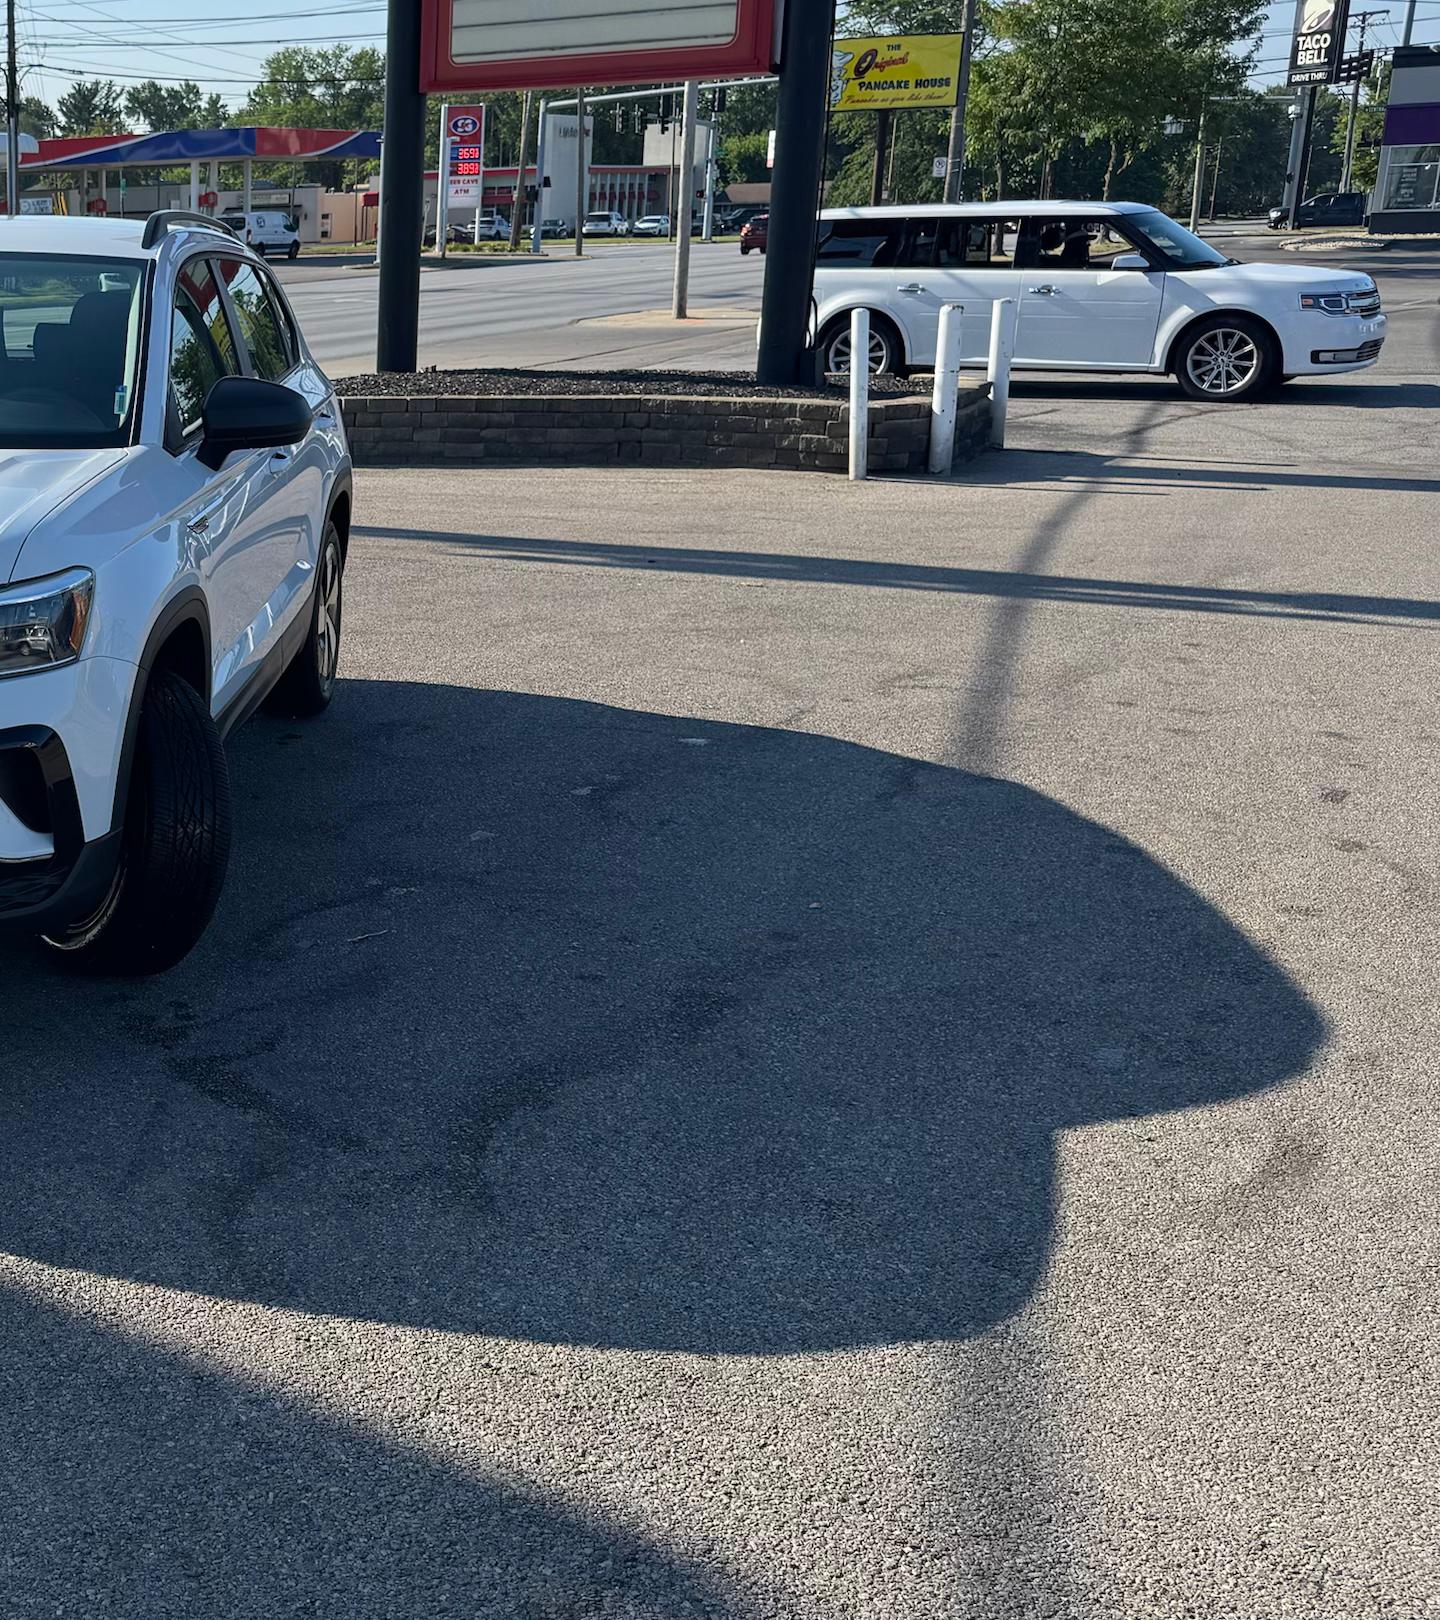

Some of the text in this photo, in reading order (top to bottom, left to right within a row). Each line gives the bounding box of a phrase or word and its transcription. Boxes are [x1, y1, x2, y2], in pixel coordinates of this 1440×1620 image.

[886, 43, 902, 51] THE
[1297, 33, 1331, 50] TACO
[854, 48, 910, 78] Original
[1297, 49, 1328, 65] BELL
[858, 77, 952, 91] PANCAKE HOUSE
[1291, 72, 1327, 82] DRIVE THRU
